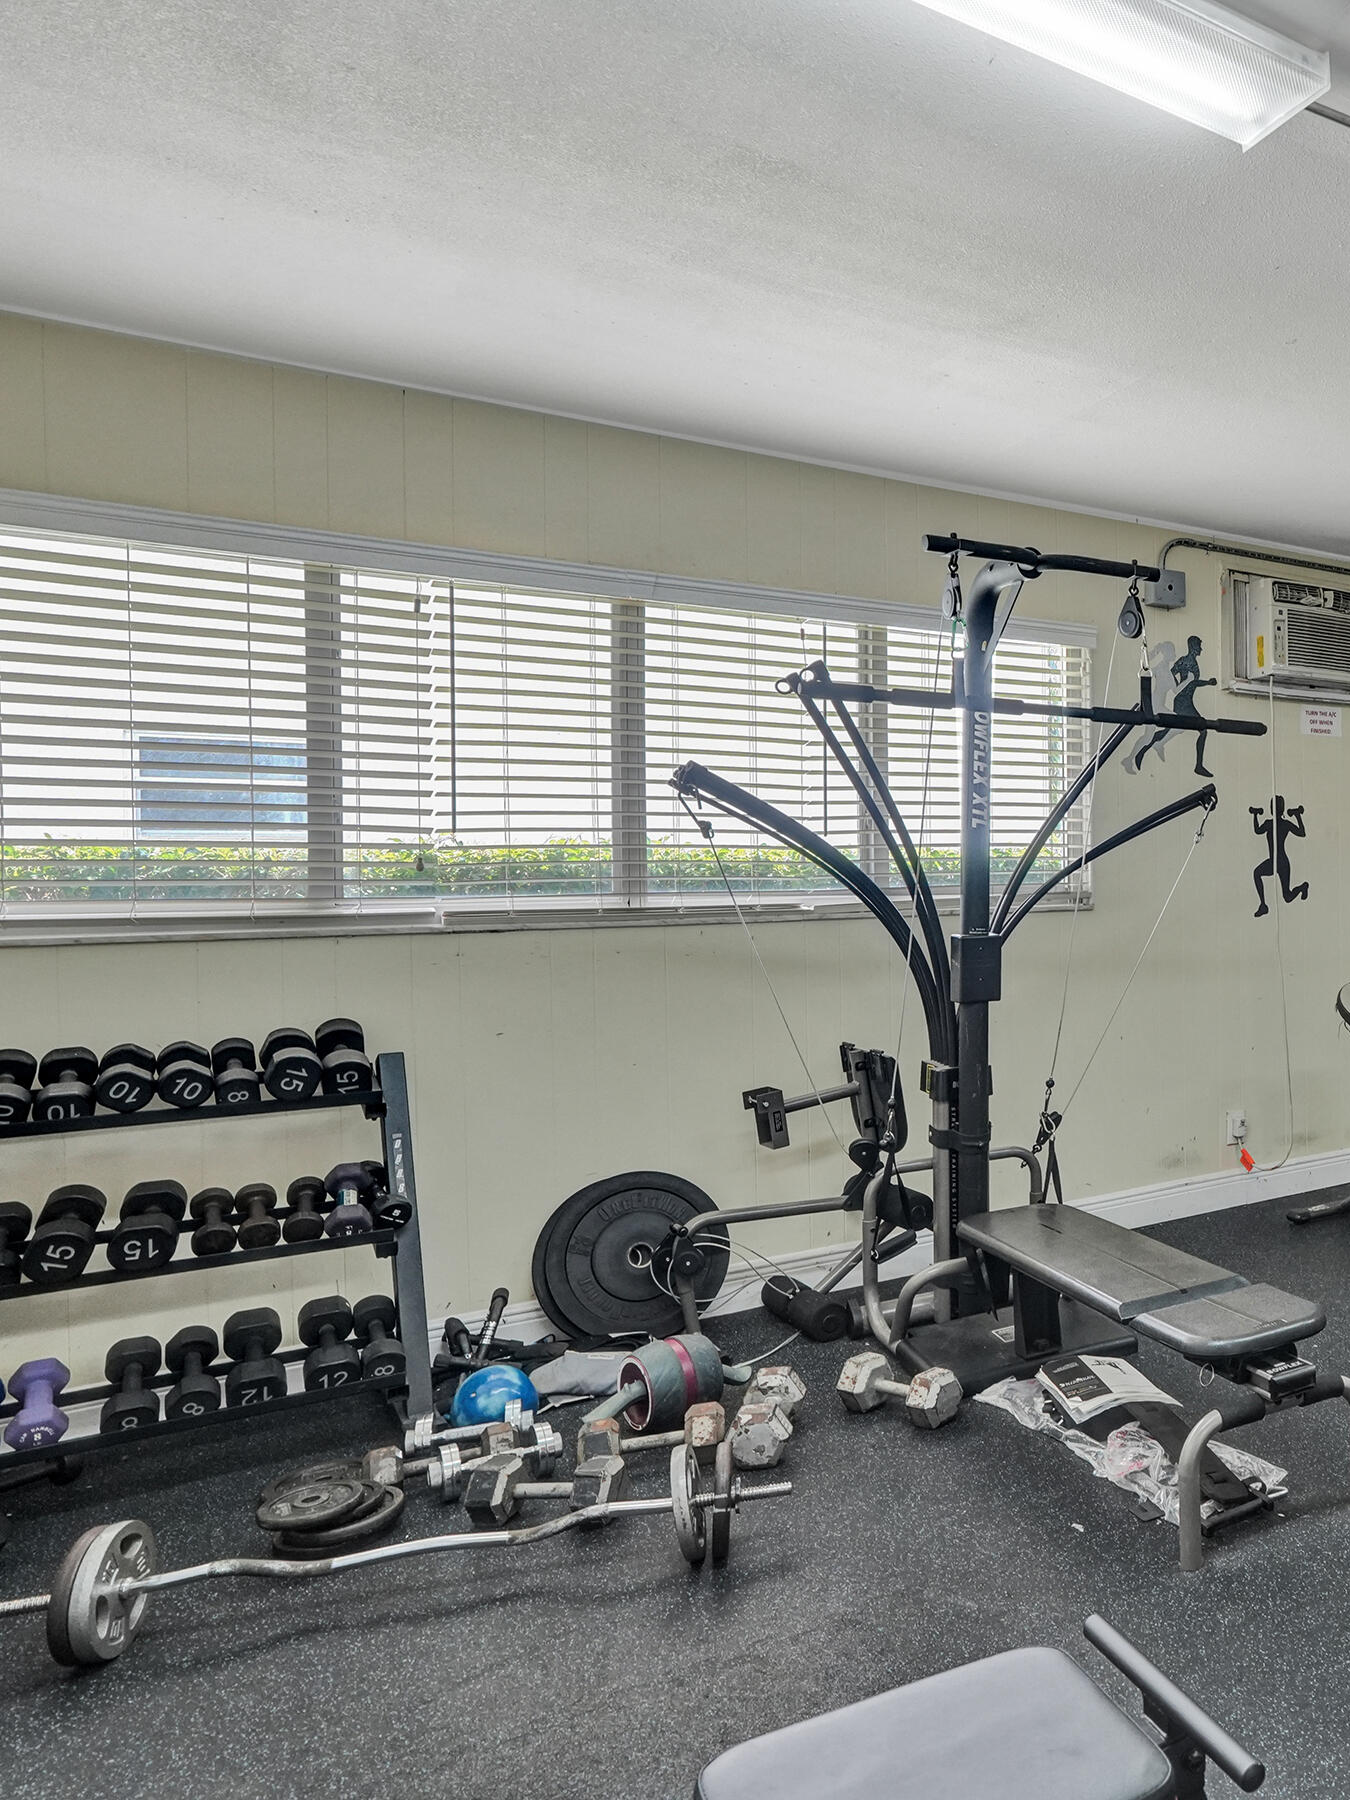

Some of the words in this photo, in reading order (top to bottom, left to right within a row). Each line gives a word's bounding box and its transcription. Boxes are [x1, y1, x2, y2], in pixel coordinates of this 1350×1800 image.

[972, 711, 990, 788] OWFLEX
[971, 791, 988, 829] XTL
[172, 1077, 203, 1100] 10
[280, 1067, 309, 1092] 15
[336, 1070, 360, 1094] 15
[109, 1081, 141, 1104] 10
[227, 1090, 249, 1103] 8
[40, 1244, 76, 1272] 15
[123, 1238, 160, 1261] 15
[1265, 1361, 1304, 1375] BOWFLEX
[318, 1371, 348, 1390] 12
[241, 1386, 273, 1407] 12
[182, 1402, 204, 1416] 8
